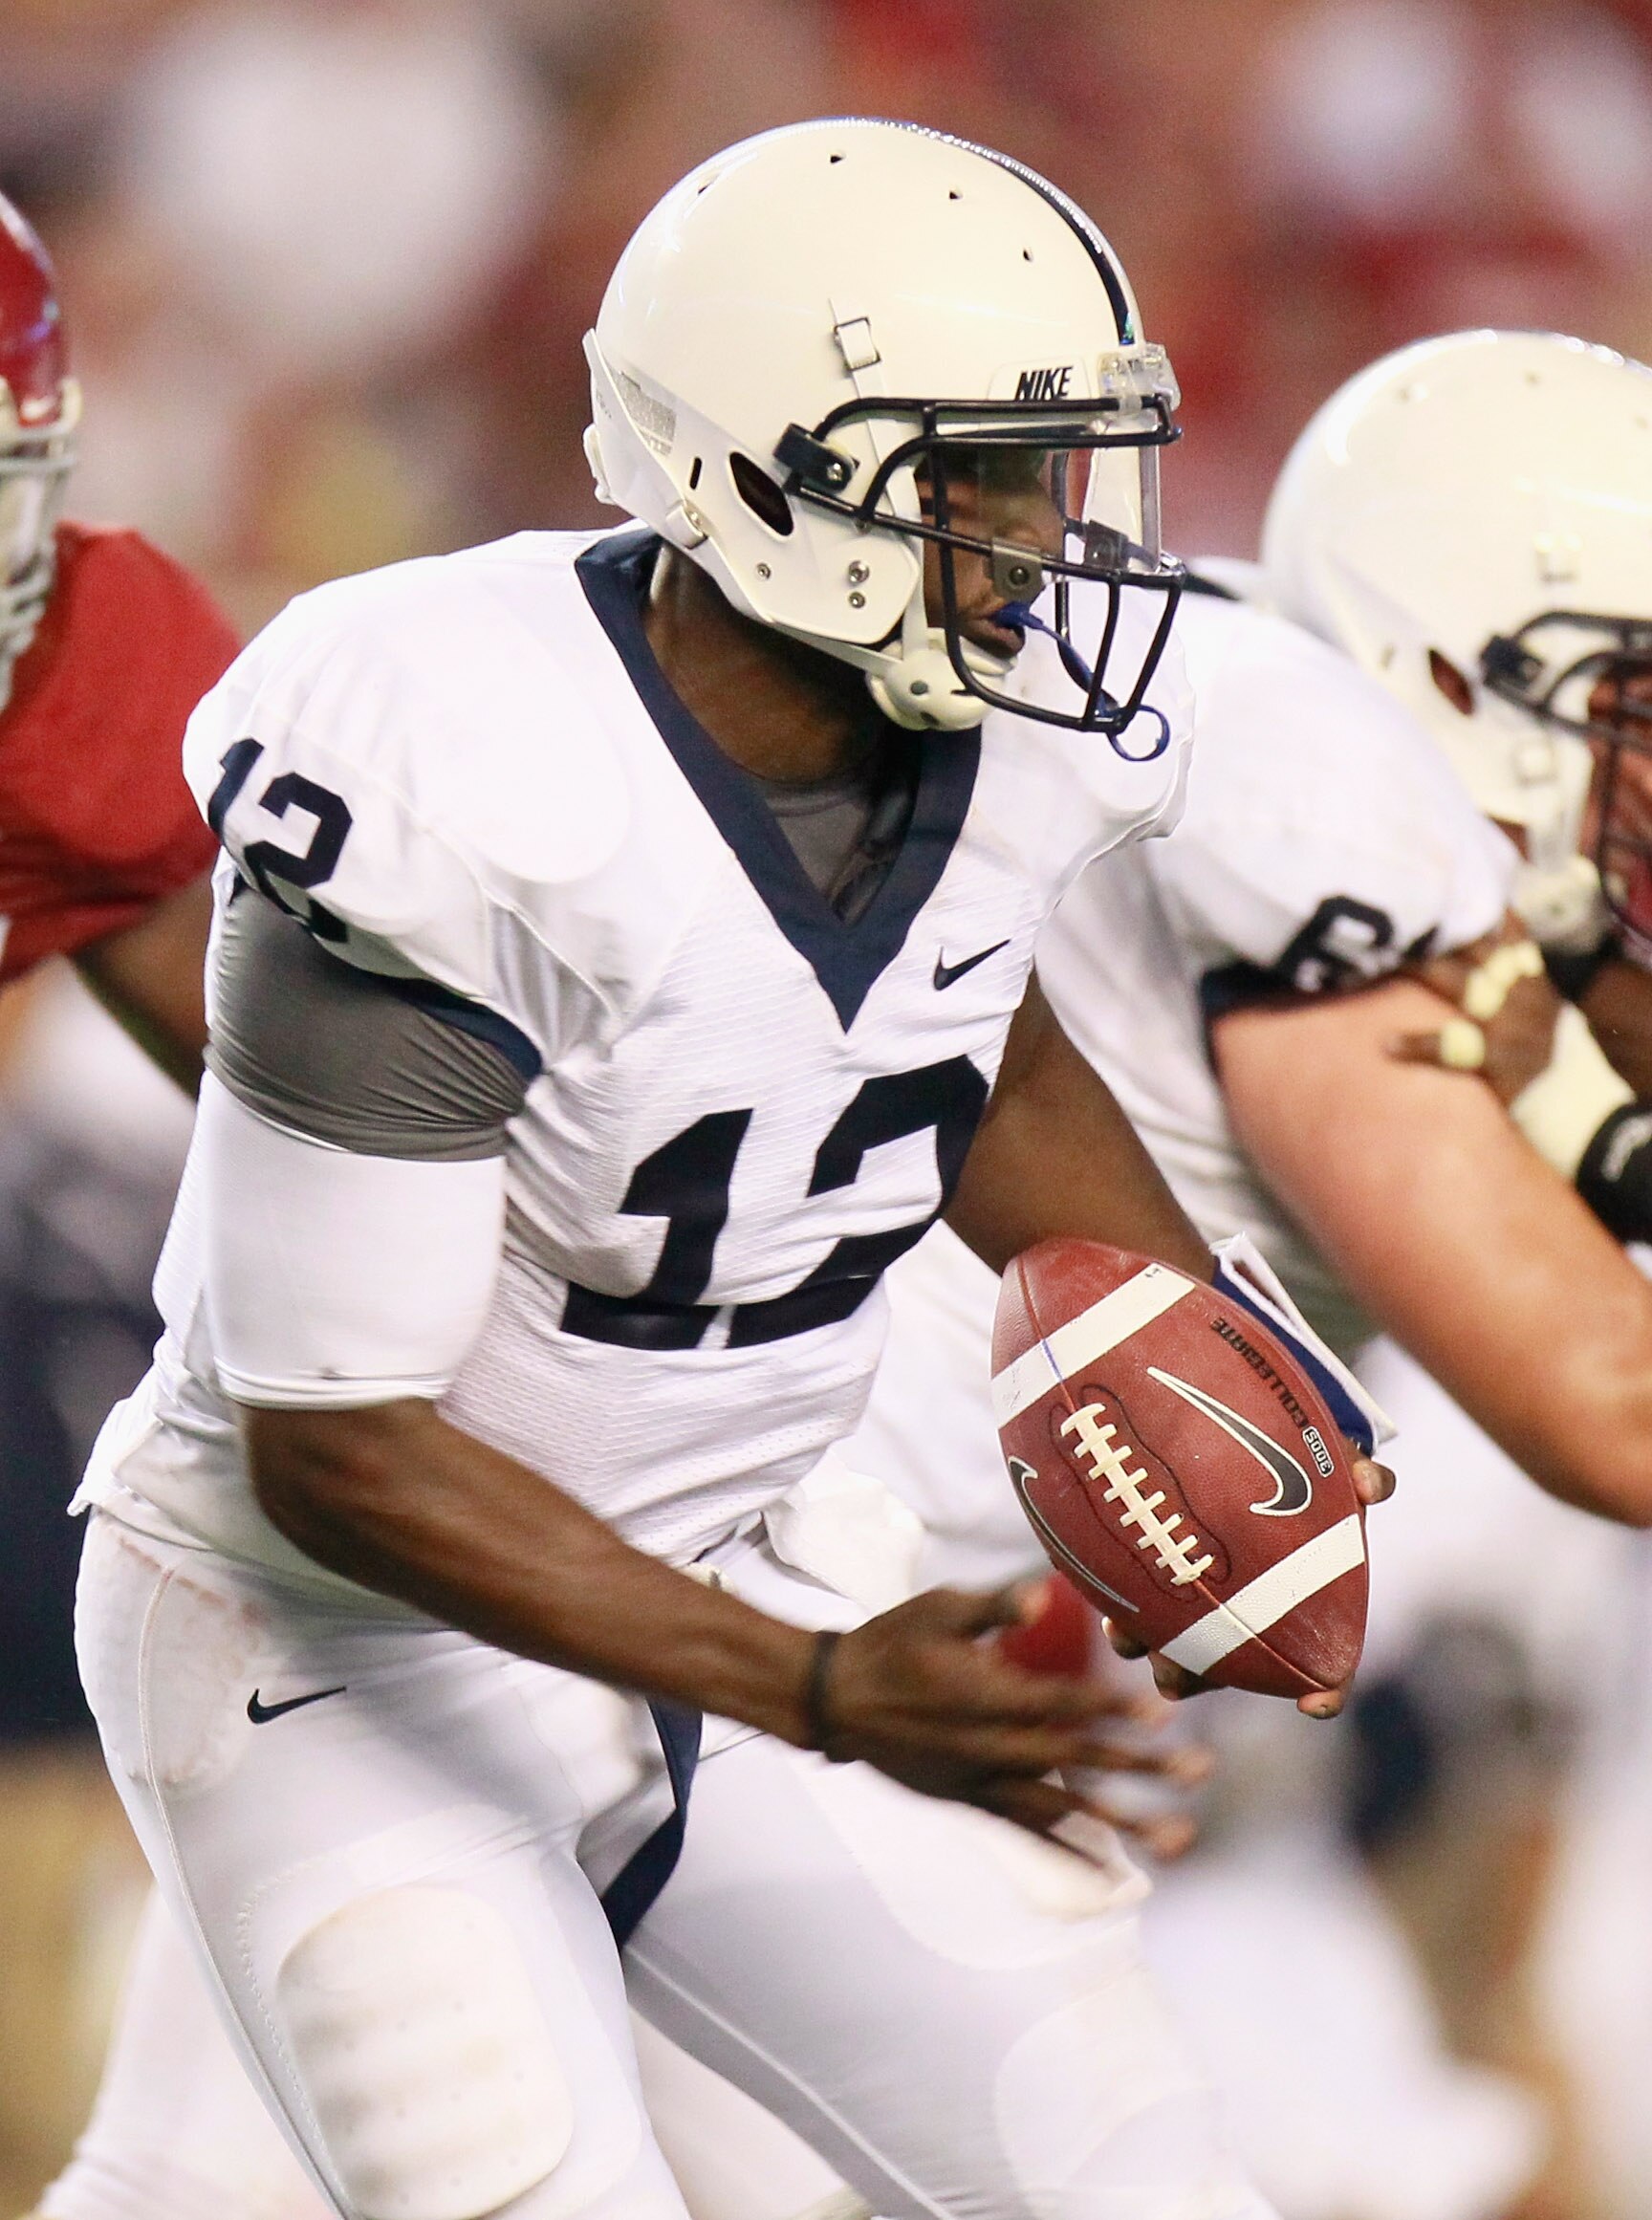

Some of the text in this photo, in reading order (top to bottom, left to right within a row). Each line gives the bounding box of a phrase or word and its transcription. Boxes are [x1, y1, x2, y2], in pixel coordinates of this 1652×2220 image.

[1015, 366, 1073, 401] NIKE
[207, 738, 353, 943] 12
[559, 1054, 989, 1351] 12
[1210, 1317, 1310, 1428] COLLEGIATE
